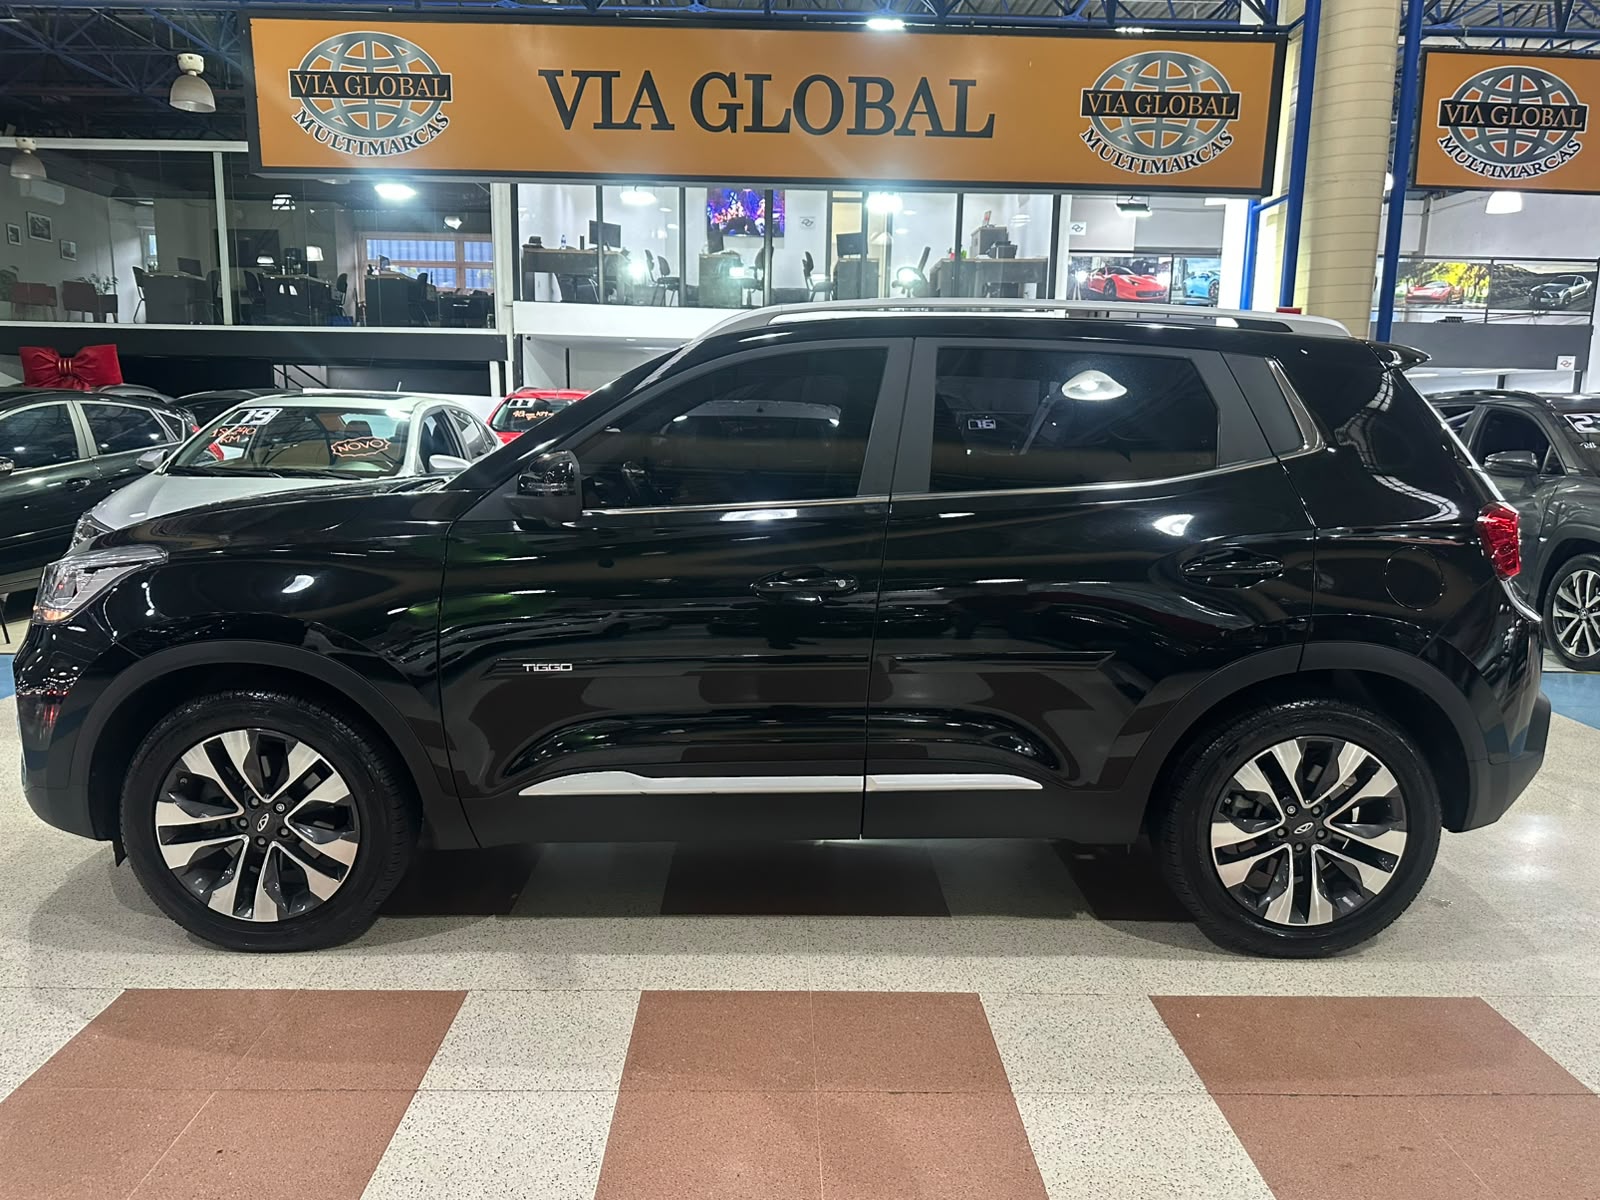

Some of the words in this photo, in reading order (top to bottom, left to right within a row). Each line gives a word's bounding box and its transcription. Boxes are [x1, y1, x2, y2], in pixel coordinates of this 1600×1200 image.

[294, 73, 339, 95] VIA
[344, 75, 448, 98] GLOBAL
[538, 69, 675, 131] VIA
[689, 71, 996, 139] GLOBAL
[1086, 93, 1129, 114] VIA
[1135, 94, 1236, 117] GLOBAL
[1444, 103, 1485, 124] VIA
[1490, 105, 1583, 128] GLOBAL
[293, 108, 449, 156] MULTIMARCAS
[1081, 126, 1233, 174] MULTIMARCAS
[1439, 136, 1581, 178] MULTIMARCAS
[241, 408, 277, 425] 19
[337, 439, 384, 452] NOVO
[522, 663, 573, 672] TIGGO
